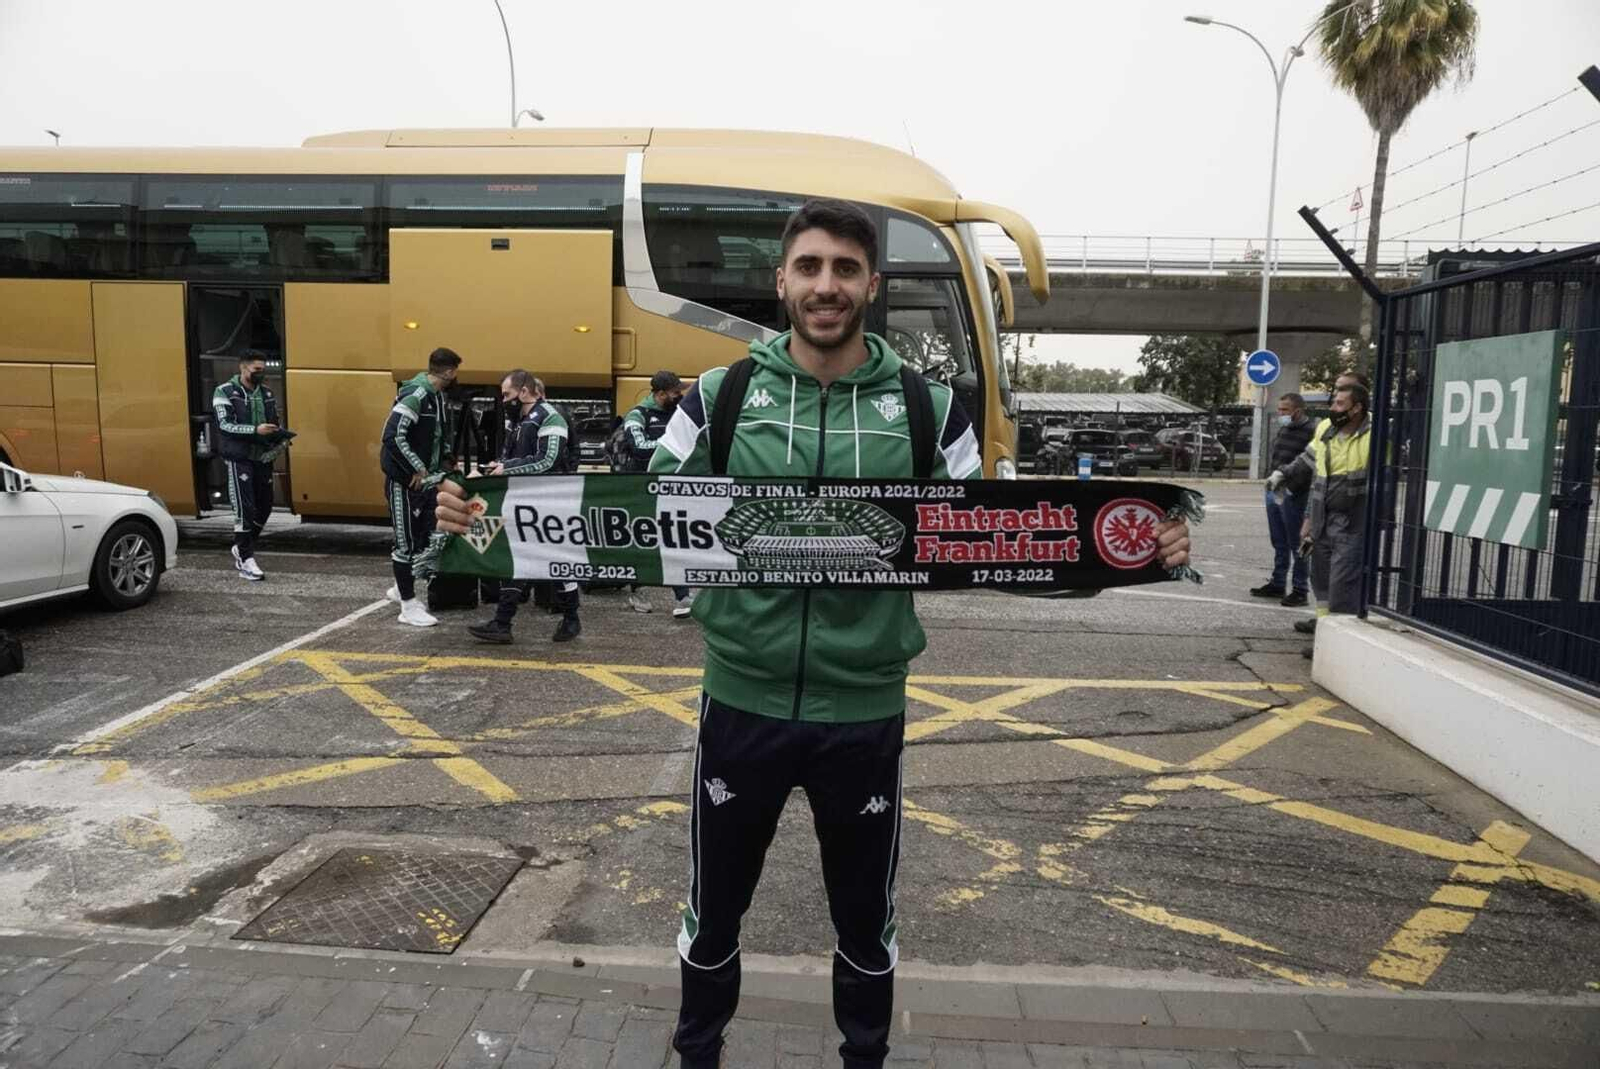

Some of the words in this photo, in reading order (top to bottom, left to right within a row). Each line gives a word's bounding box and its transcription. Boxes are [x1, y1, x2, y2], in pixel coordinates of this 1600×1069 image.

[1440, 376, 1530, 451] PR1
[647, 481, 728, 496] OCTAVOS
[731, 484, 752, 497] DE
[756, 485, 806, 498] FINAL
[818, 485, 882, 498] EUROPA
[884, 485, 966, 498] 2021/2022
[915, 501, 1079, 532] Eintracht
[914, 532, 1081, 563] Frankfurt
[550, 563, 637, 579] 09-03-2022
[686, 570, 760, 583] ESTADIO
[763, 571, 824, 584] BENITO
[826, 571, 930, 584] VILLAMARIN
[972, 569, 1054, 583] 17-03-2022
